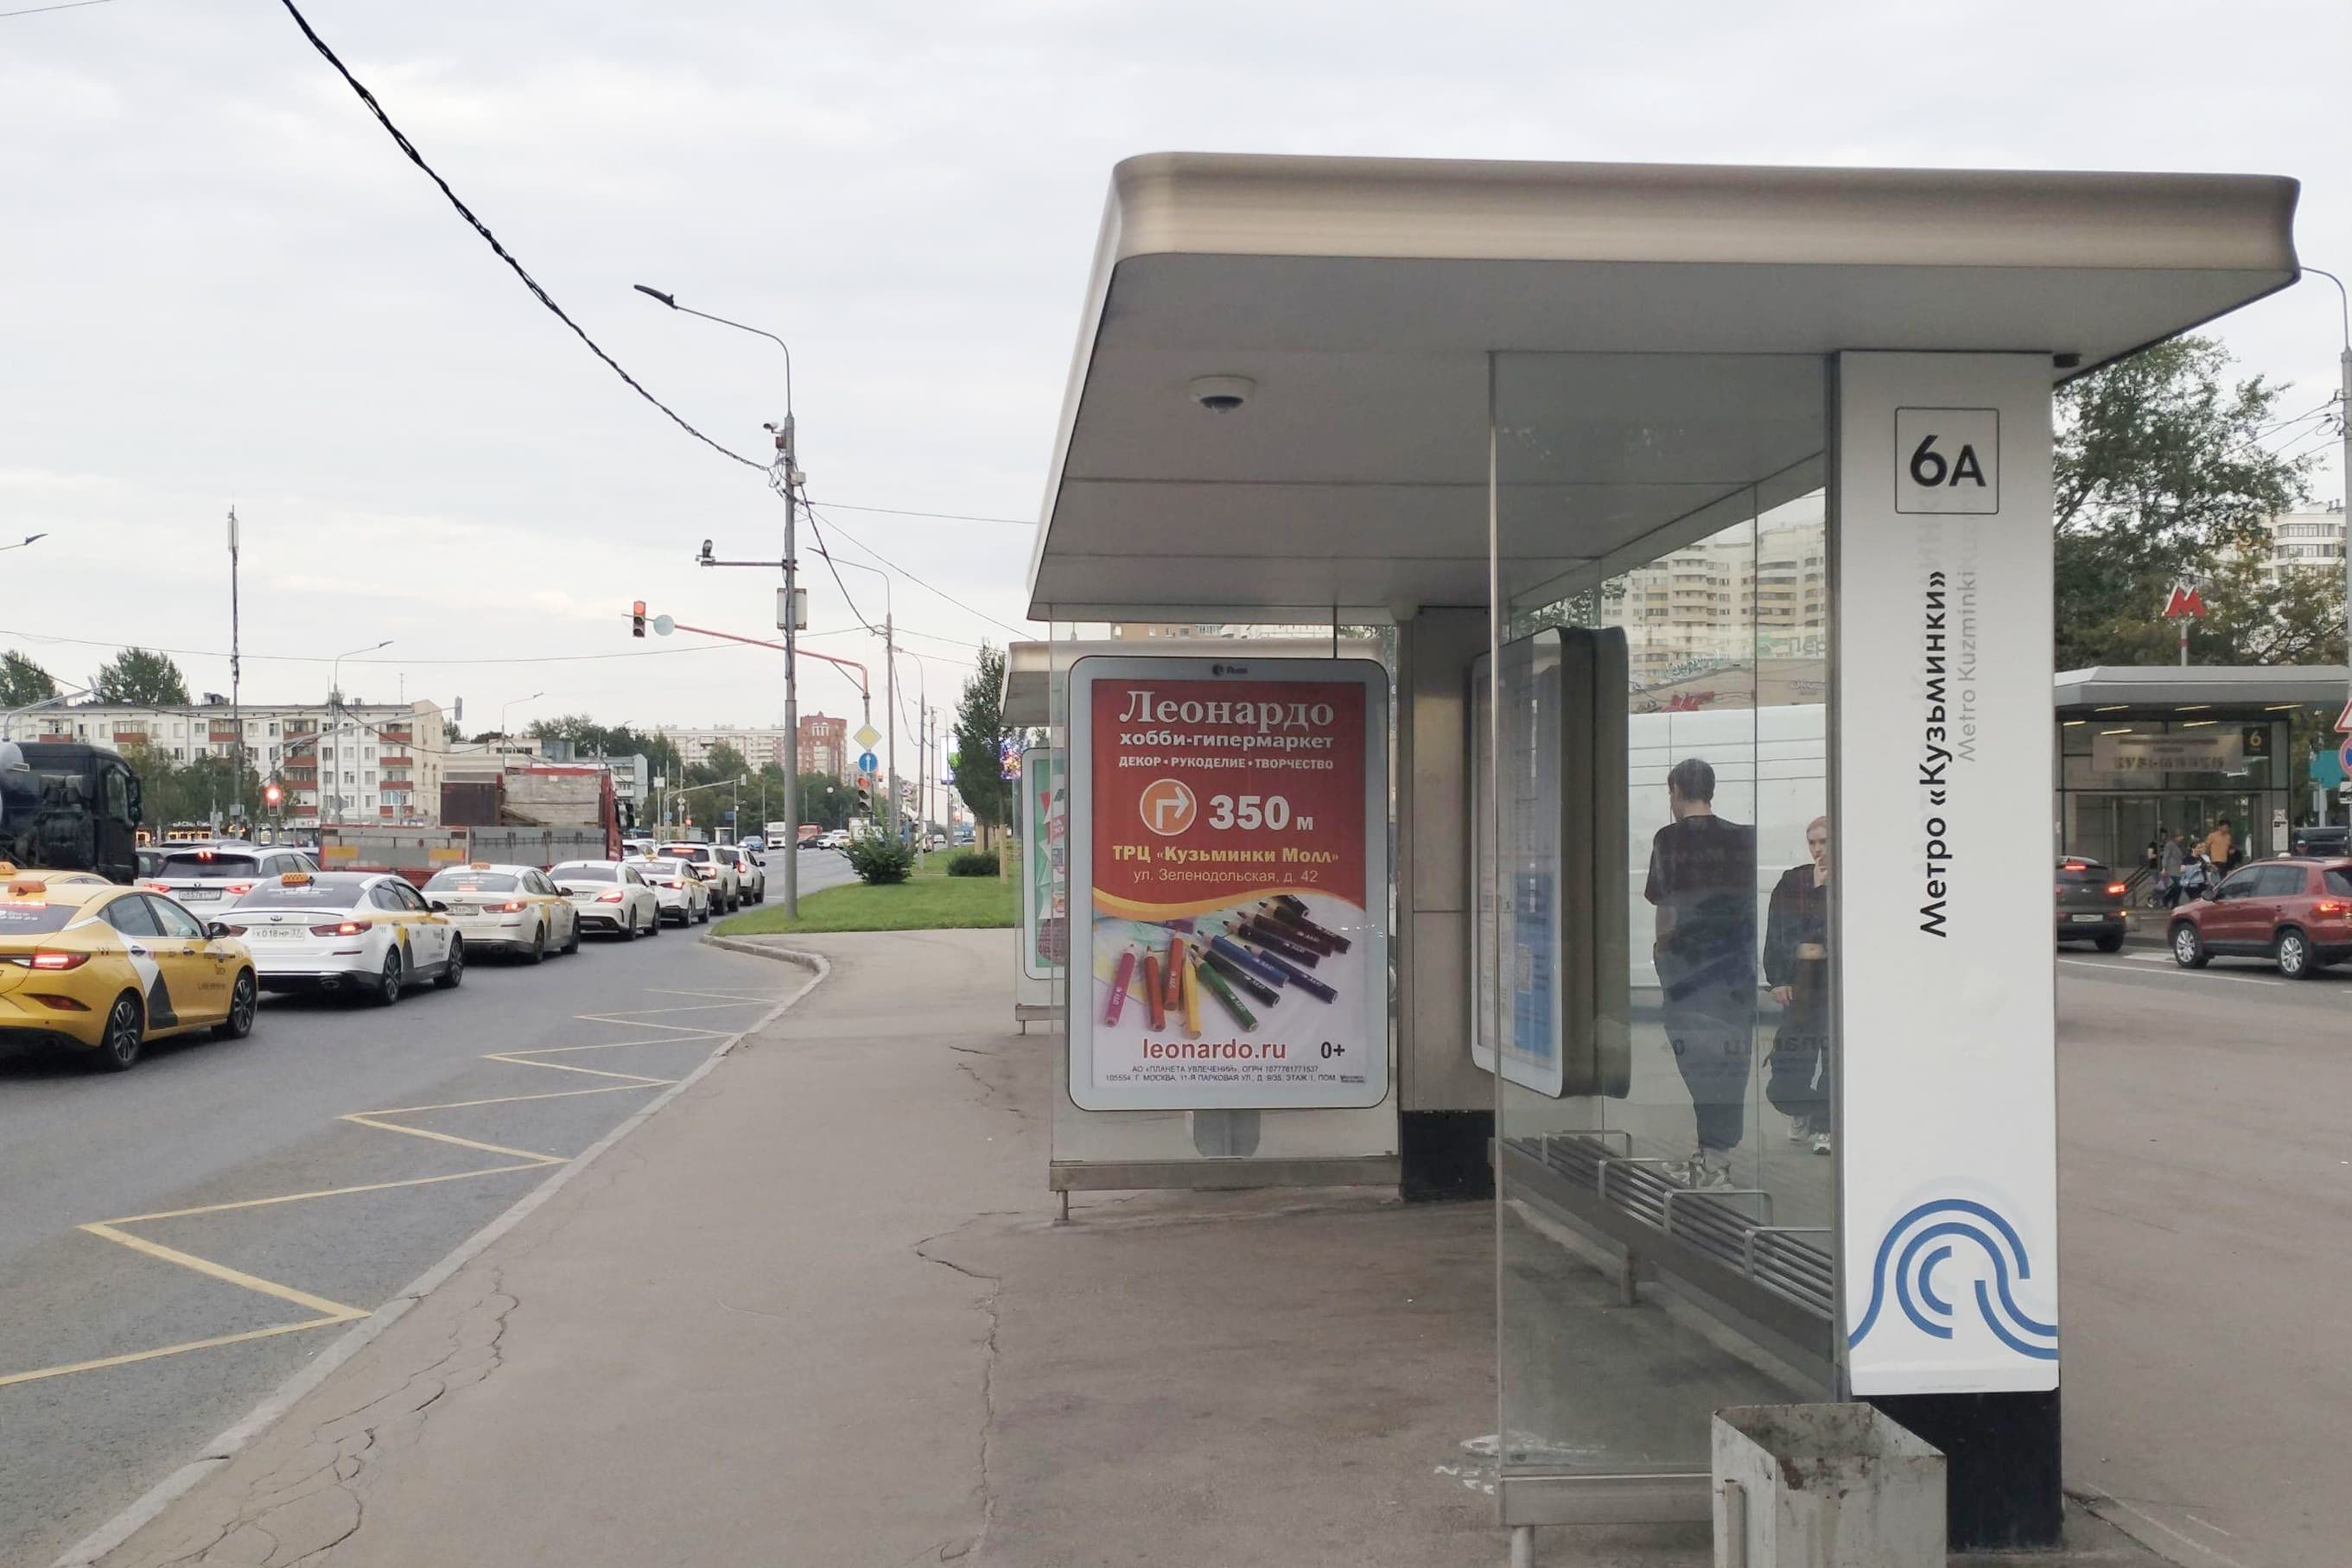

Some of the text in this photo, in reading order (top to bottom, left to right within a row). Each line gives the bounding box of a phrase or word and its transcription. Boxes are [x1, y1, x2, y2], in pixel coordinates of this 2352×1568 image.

[1910, 435, 1986, 487] 6А
[1956, 571, 1976, 762] Metro Kuzminki
[1919, 571, 1953, 806] «Кузьминки»
[1119, 691, 1334, 733] Леонардо
[1120, 730, 1334, 752] хобби-гипермаркет
[1119, 756, 1333, 769] ДЕКОР РУКОДЕЛИЕ ТВОРЧЕСТВО
[1209, 795, 1313, 830] 350 м
[1113, 846, 1151, 863] ТРЦ
[1157, 847, 1275, 864] «Кузьминки
[1134, 871, 1154, 883] ул.
[1159, 868, 1279, 883] Зеленодольская,
[1300, 871, 1319, 882] 42
[1920, 817, 1953, 938] Метро
[1143, 1038, 1287, 1059] leonardo.ru
[1320, 1042, 1345, 1059] 0+
